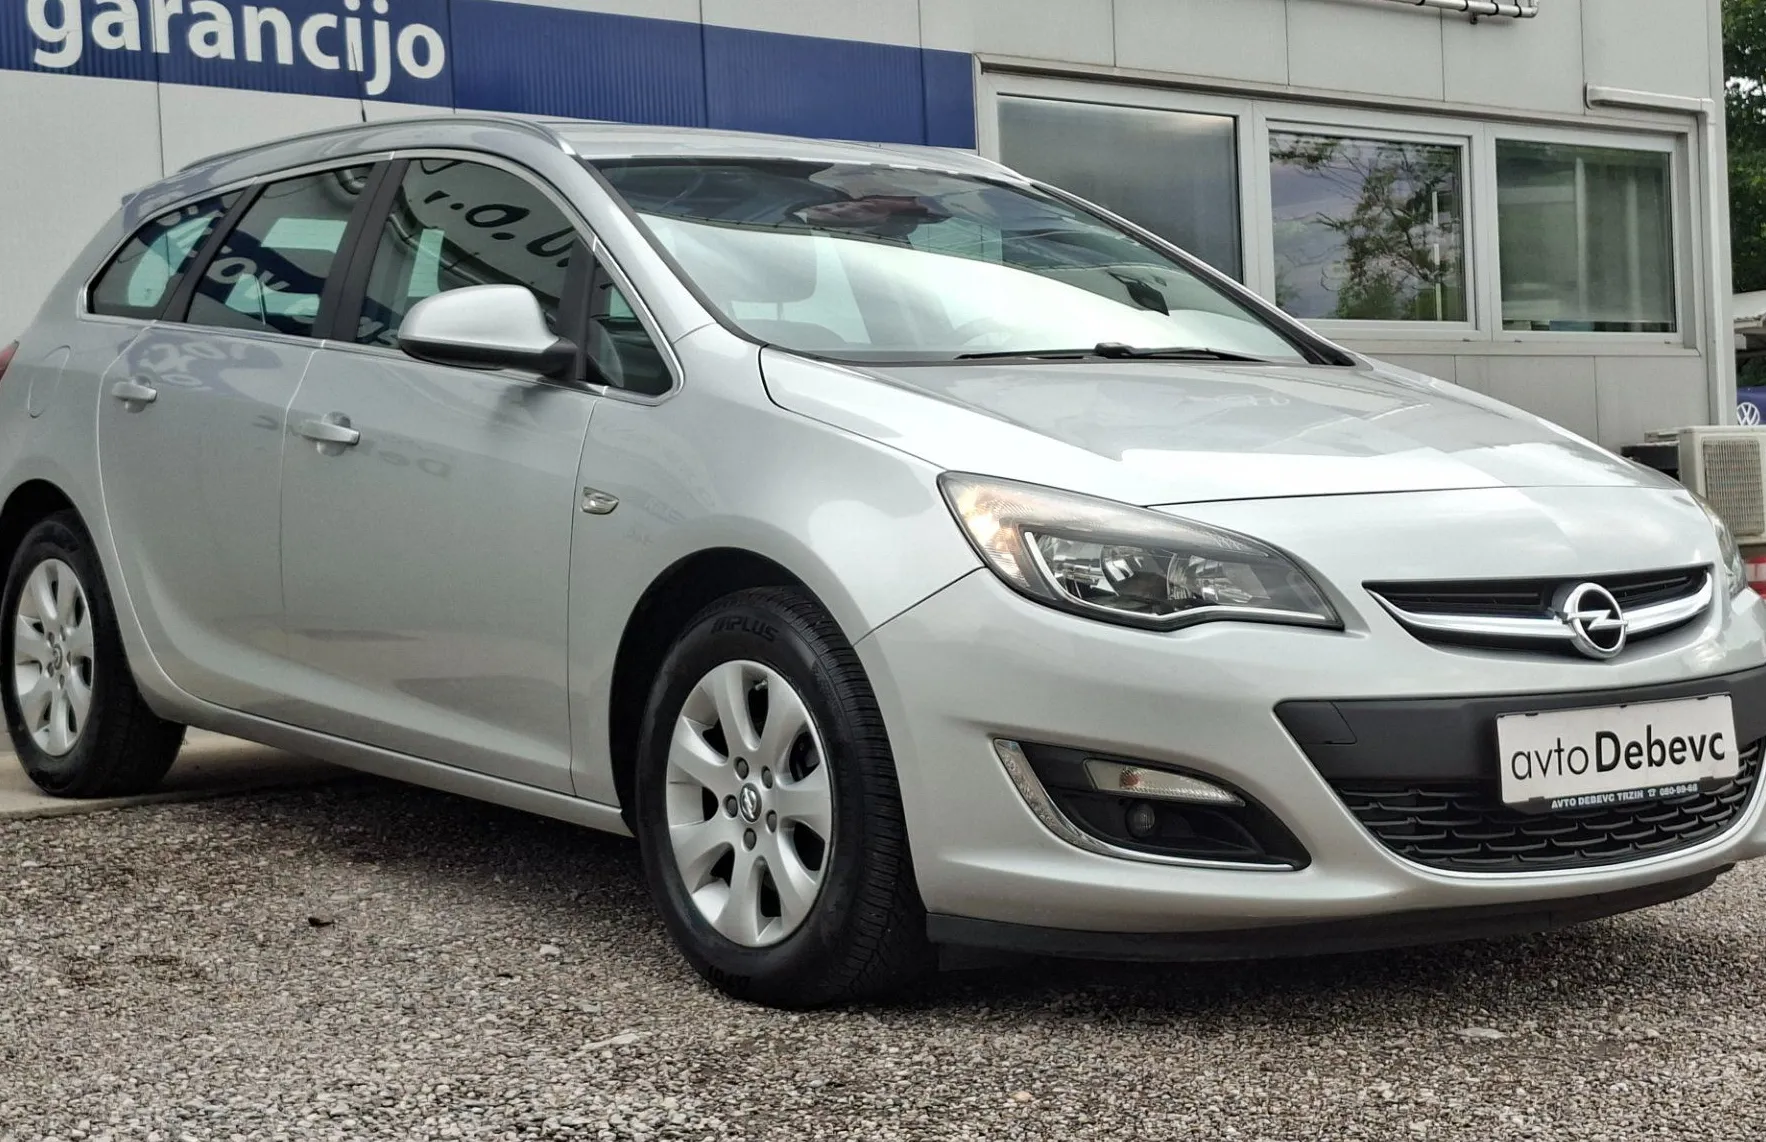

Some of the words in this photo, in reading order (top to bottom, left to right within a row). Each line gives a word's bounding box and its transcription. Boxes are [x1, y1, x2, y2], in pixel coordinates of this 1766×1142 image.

[26, 0, 445, 95] garancijo
[1551, 797, 1577, 809] AVTO
[1578, 793, 1615, 806] DEBEVC
[1616, 790, 1643, 801] TRZIN
